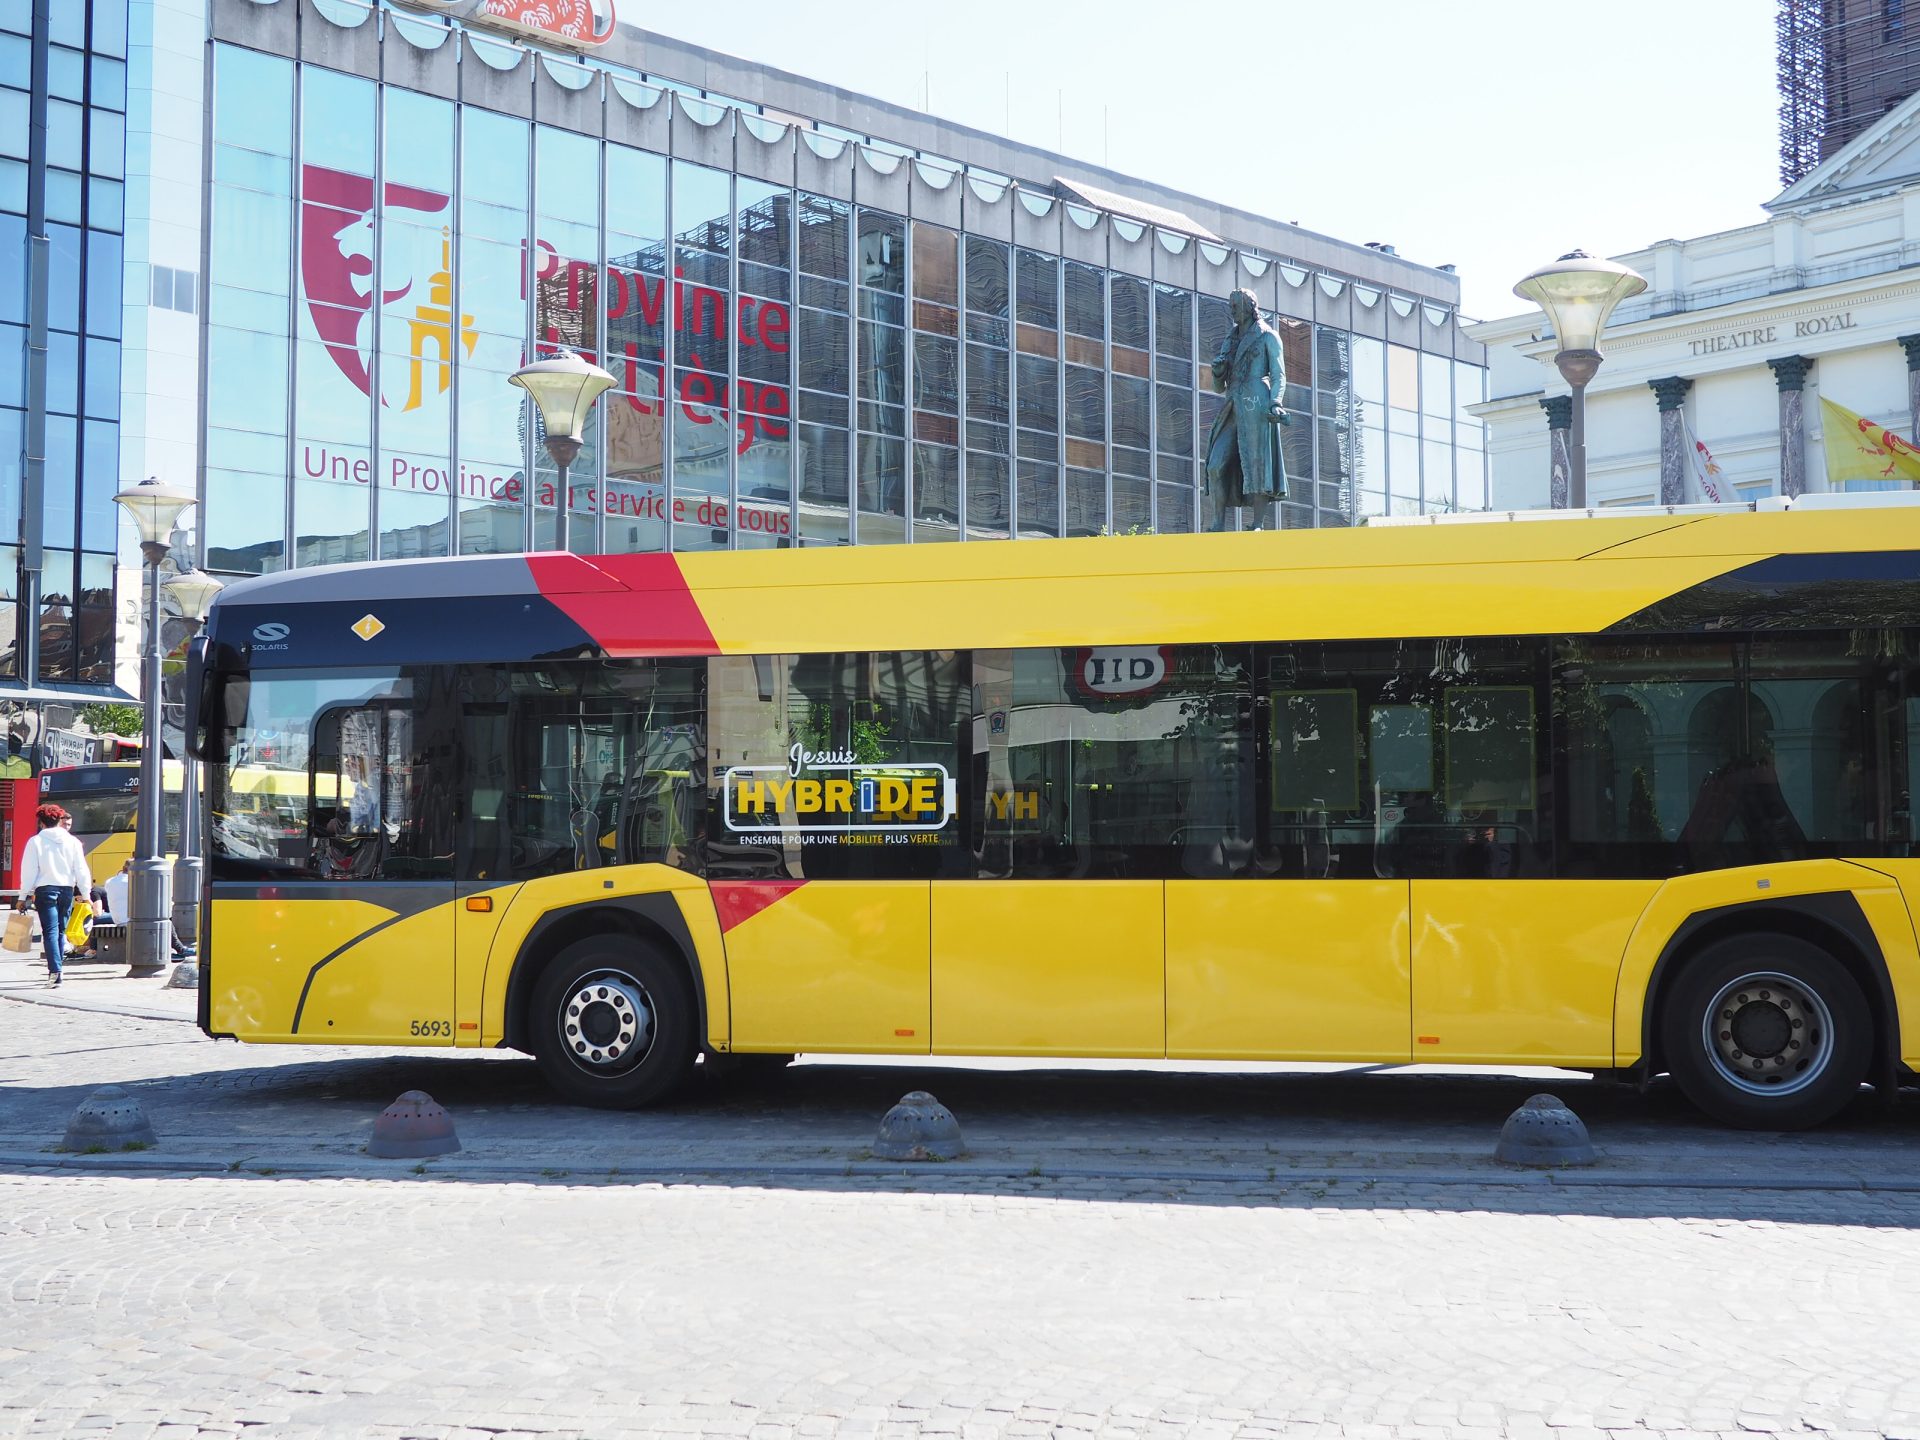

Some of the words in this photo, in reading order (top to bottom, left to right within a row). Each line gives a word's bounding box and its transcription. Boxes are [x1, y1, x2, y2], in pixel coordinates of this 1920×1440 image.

[521, 238, 790, 353] Province
[1688, 326, 1777, 356] THEATRE
[1794, 312, 1858, 338] ROYAL
[625, 342, 790, 456] Liège
[305, 447, 369, 483] Une
[392, 458, 520, 502] Province
[588, 490, 685, 523] service
[697, 496, 728, 527] de
[738, 505, 790, 534] tous
[251, 643, 289, 651] SOLARIS
[737, 777, 937, 814] HYBRIDE
[740, 835, 787, 845] ENSEMBLE
[788, 835, 815, 845] POUR
[817, 835, 838, 845] UNE
[885, 834, 909, 844] PLUS
[910, 833, 939, 844] VERTE
[410, 1020, 451, 1037] 5693
